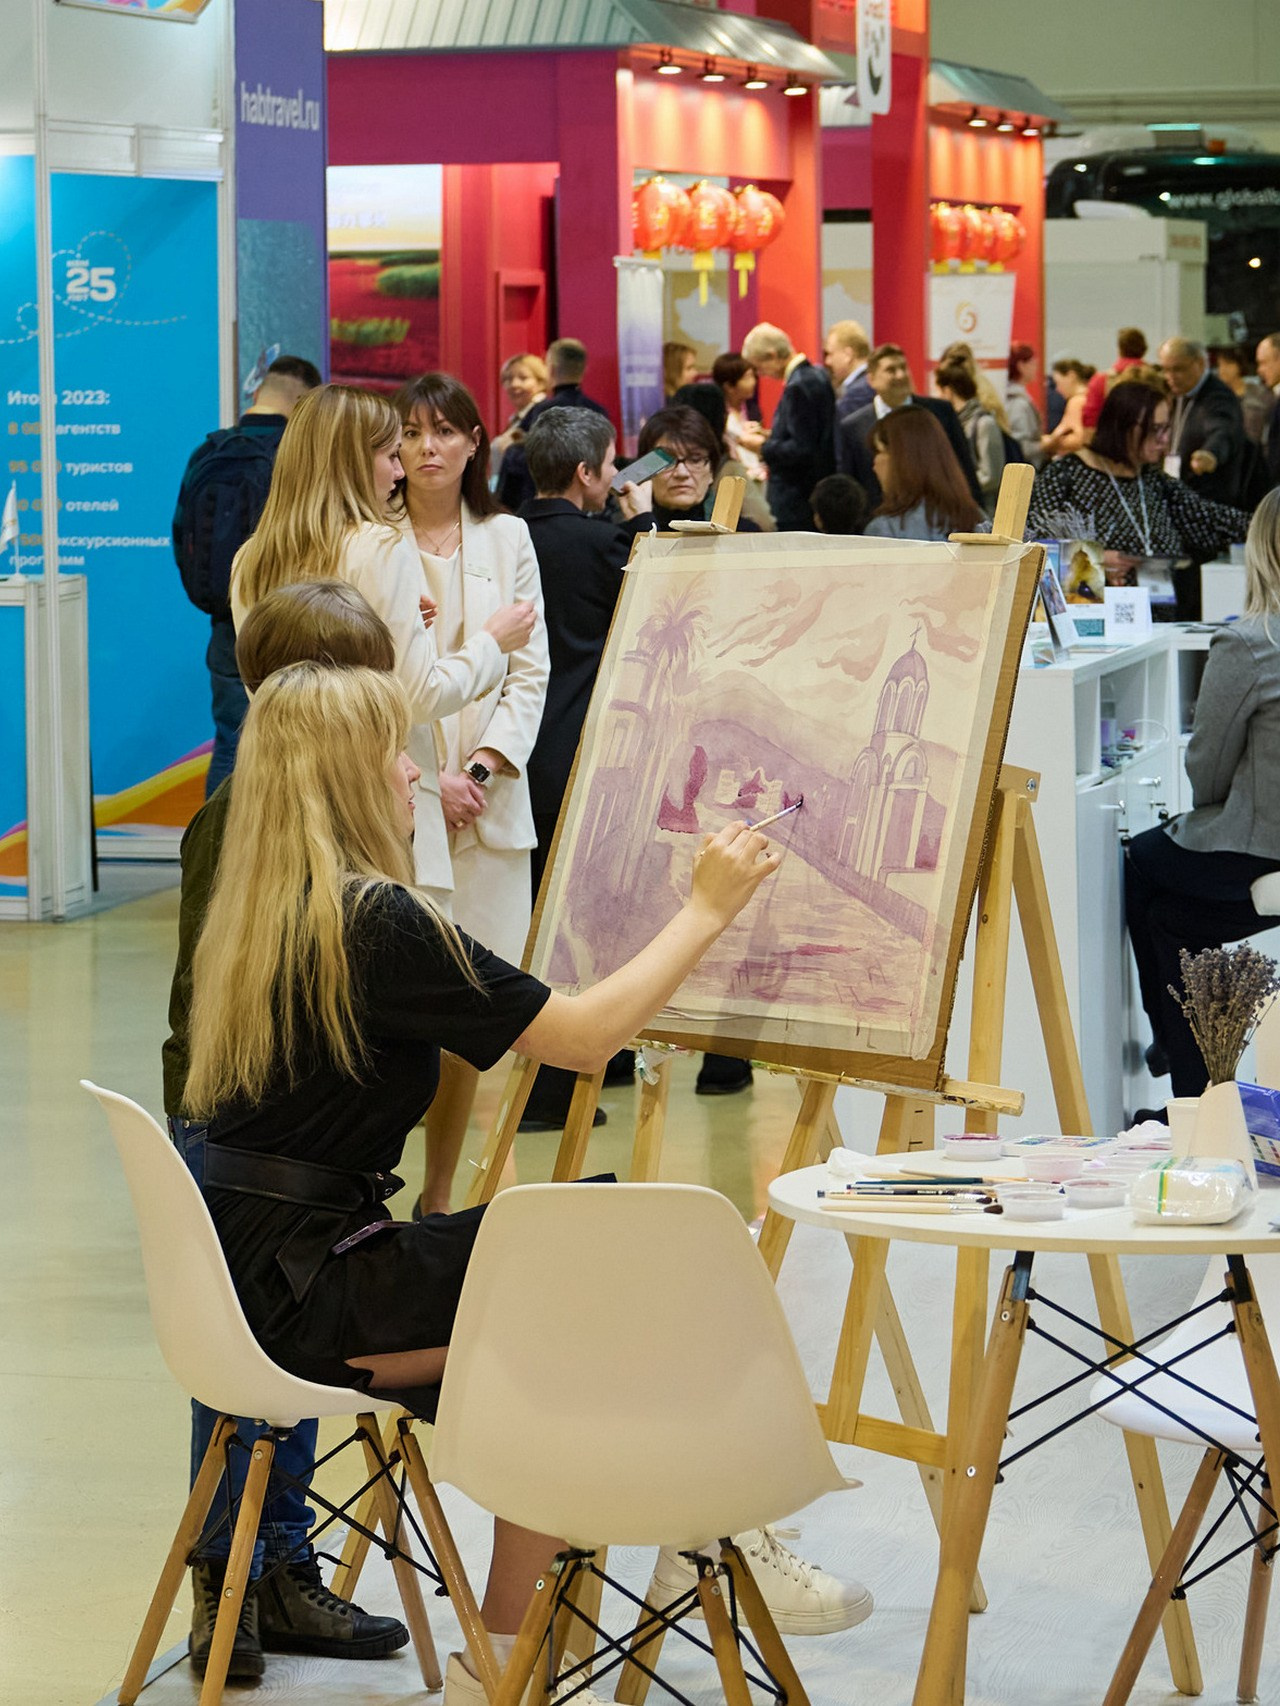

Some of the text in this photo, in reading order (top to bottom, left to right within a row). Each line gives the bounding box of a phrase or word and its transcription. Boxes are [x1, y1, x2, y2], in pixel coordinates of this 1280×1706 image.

[240, 81, 320, 131] habtravel.ru
[66, 267, 116, 301] 25
[7, 390, 111, 405] Ито 2023:
